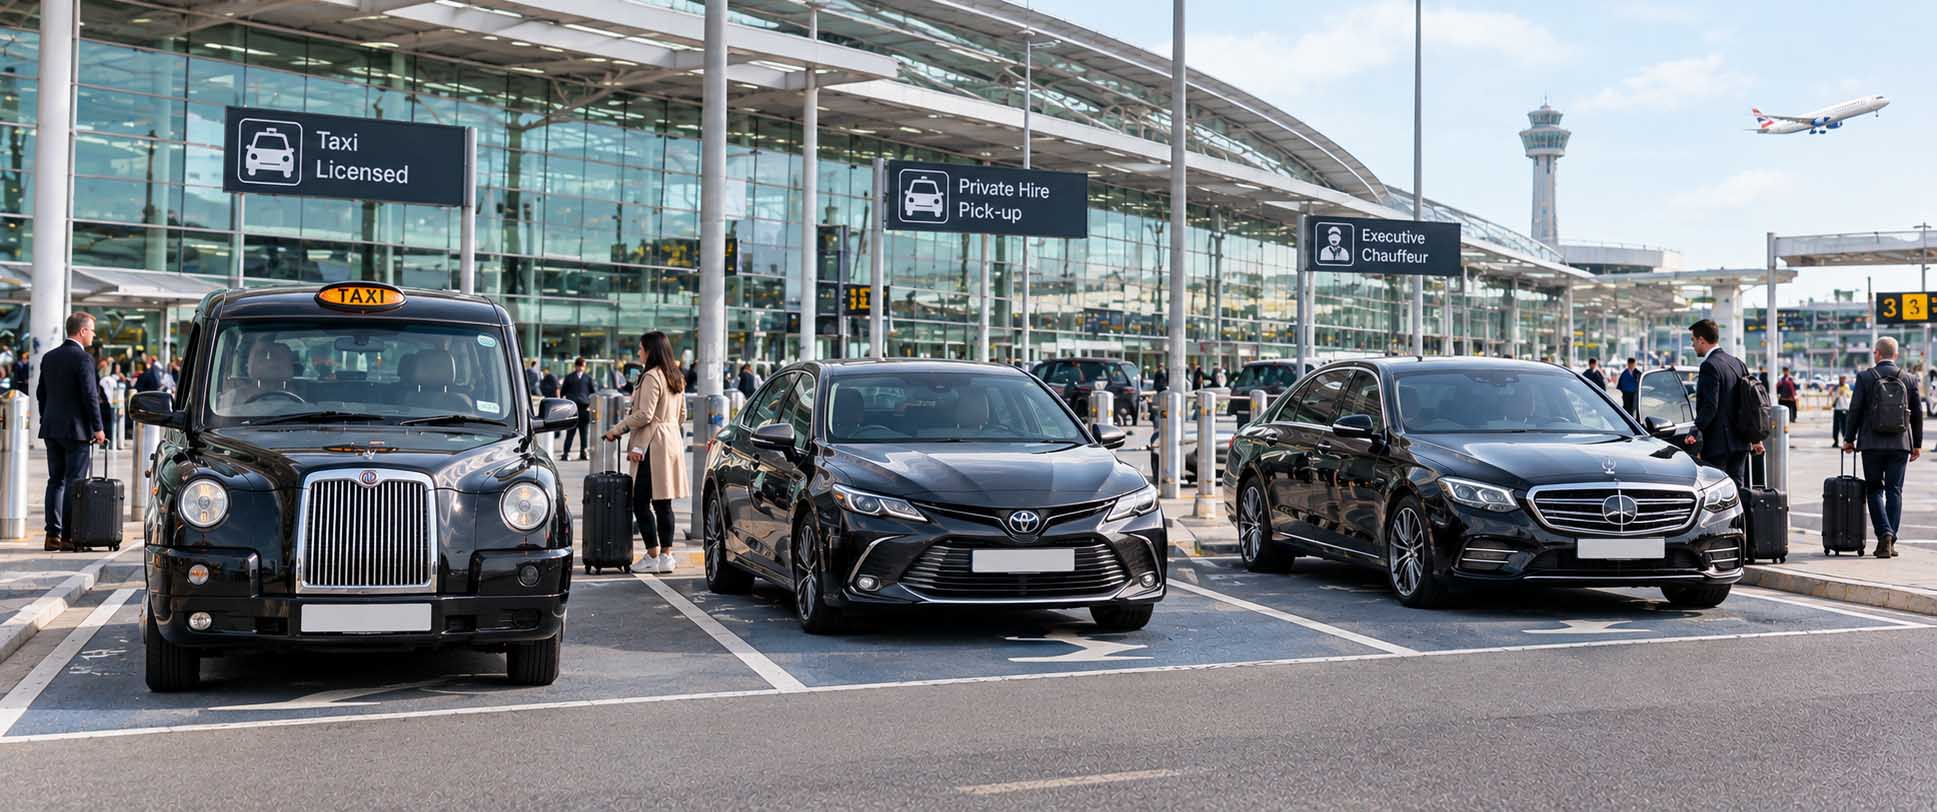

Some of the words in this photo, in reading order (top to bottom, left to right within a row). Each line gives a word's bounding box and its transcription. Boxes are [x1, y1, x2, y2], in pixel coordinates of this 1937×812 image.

[316, 130, 358, 152] Taxi
[316, 160, 409, 184] Licensed
[959, 178, 1014, 197] Private
[1019, 182, 1050, 198] Hire
[959, 202, 1022, 223] Pick-up
[1362, 228, 1425, 244] Executive
[1362, 248, 1429, 264] Chauffeur
[338, 288, 384, 303] TAXI
[1882, 297, 1897, 318] 3
[1909, 299, 1920, 315] 3
